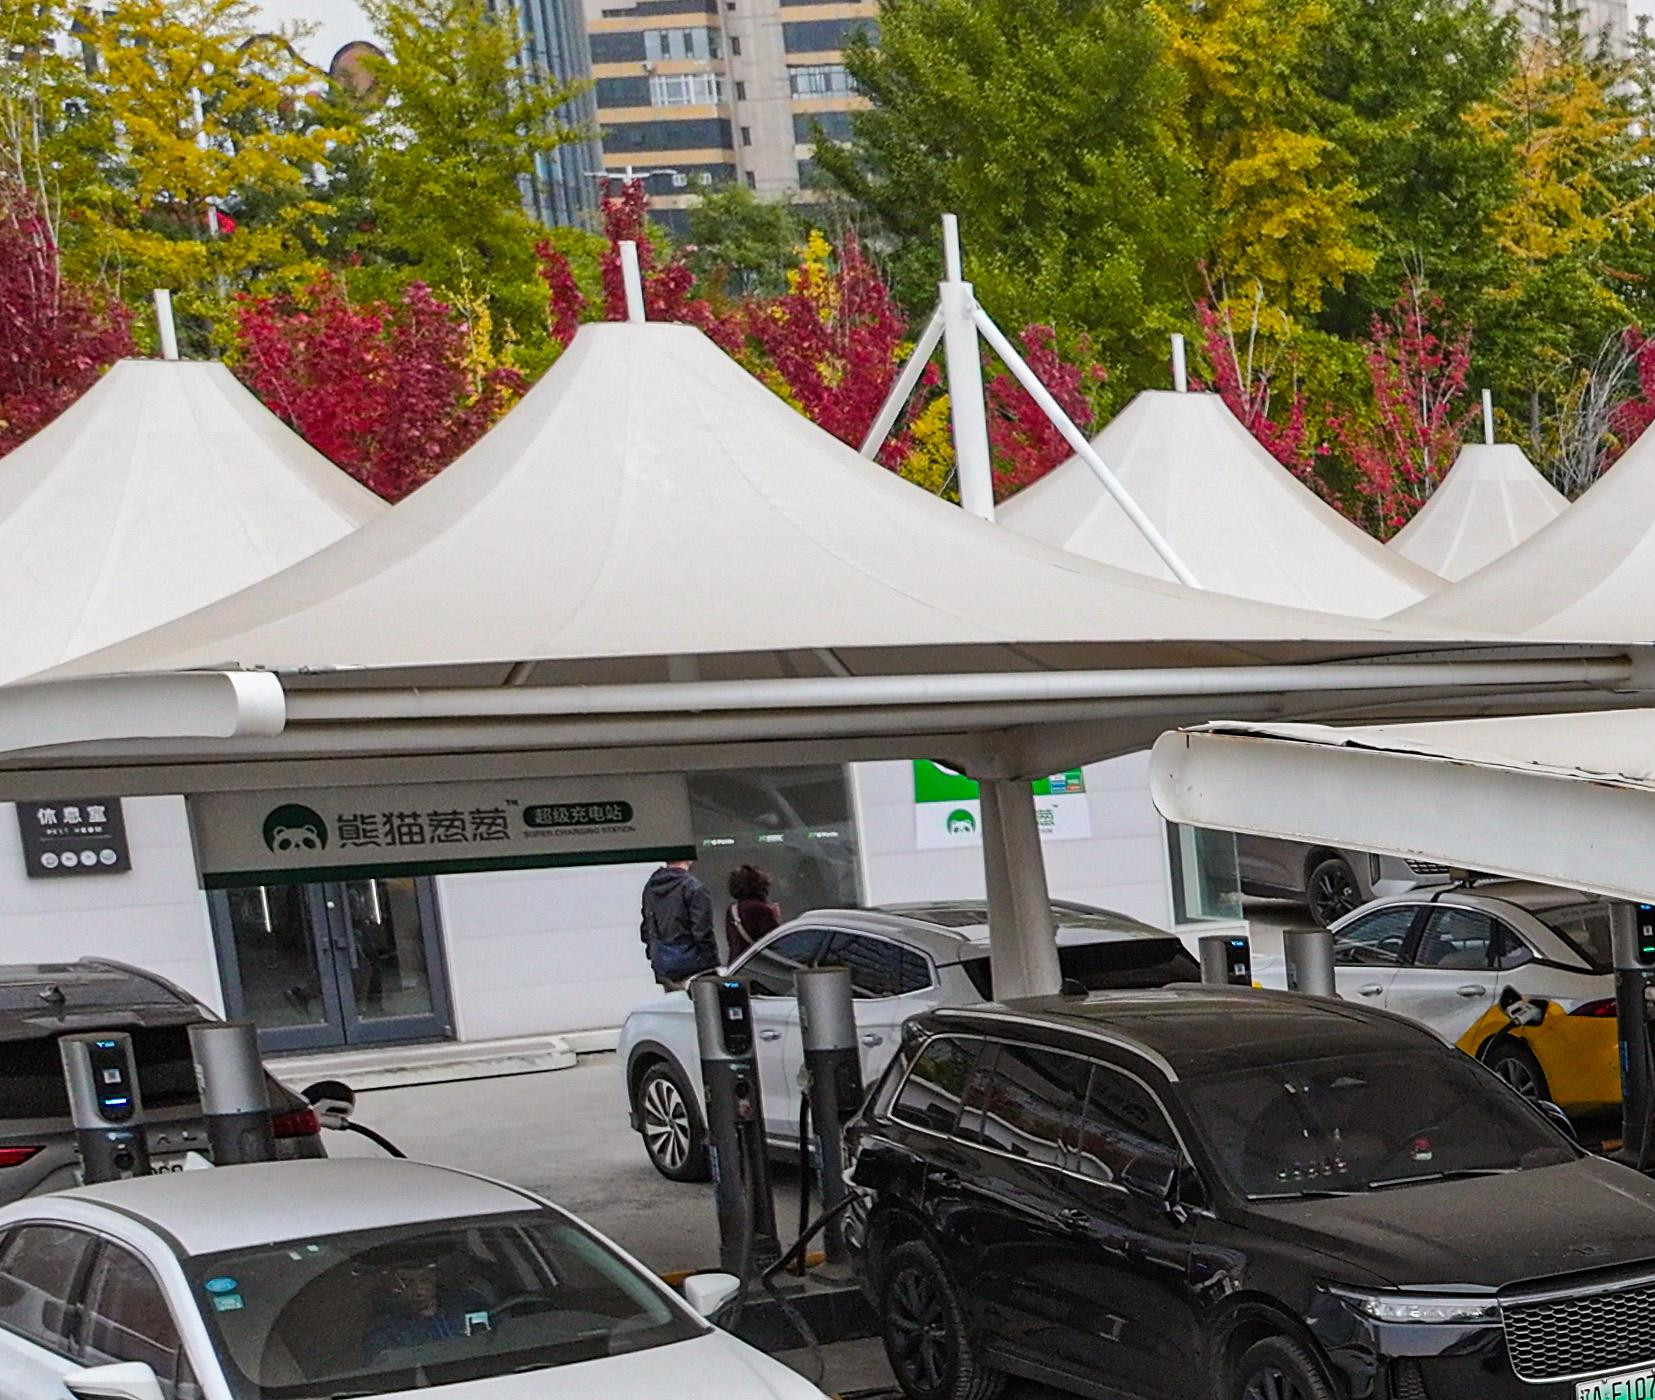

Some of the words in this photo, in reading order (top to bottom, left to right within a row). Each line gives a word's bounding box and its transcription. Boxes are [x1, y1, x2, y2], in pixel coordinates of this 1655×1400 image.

[37, 805, 107, 825] 休息室
[534, 805, 623, 825] 超级充电站
[336, 807, 511, 848] 熊猫葱葱
